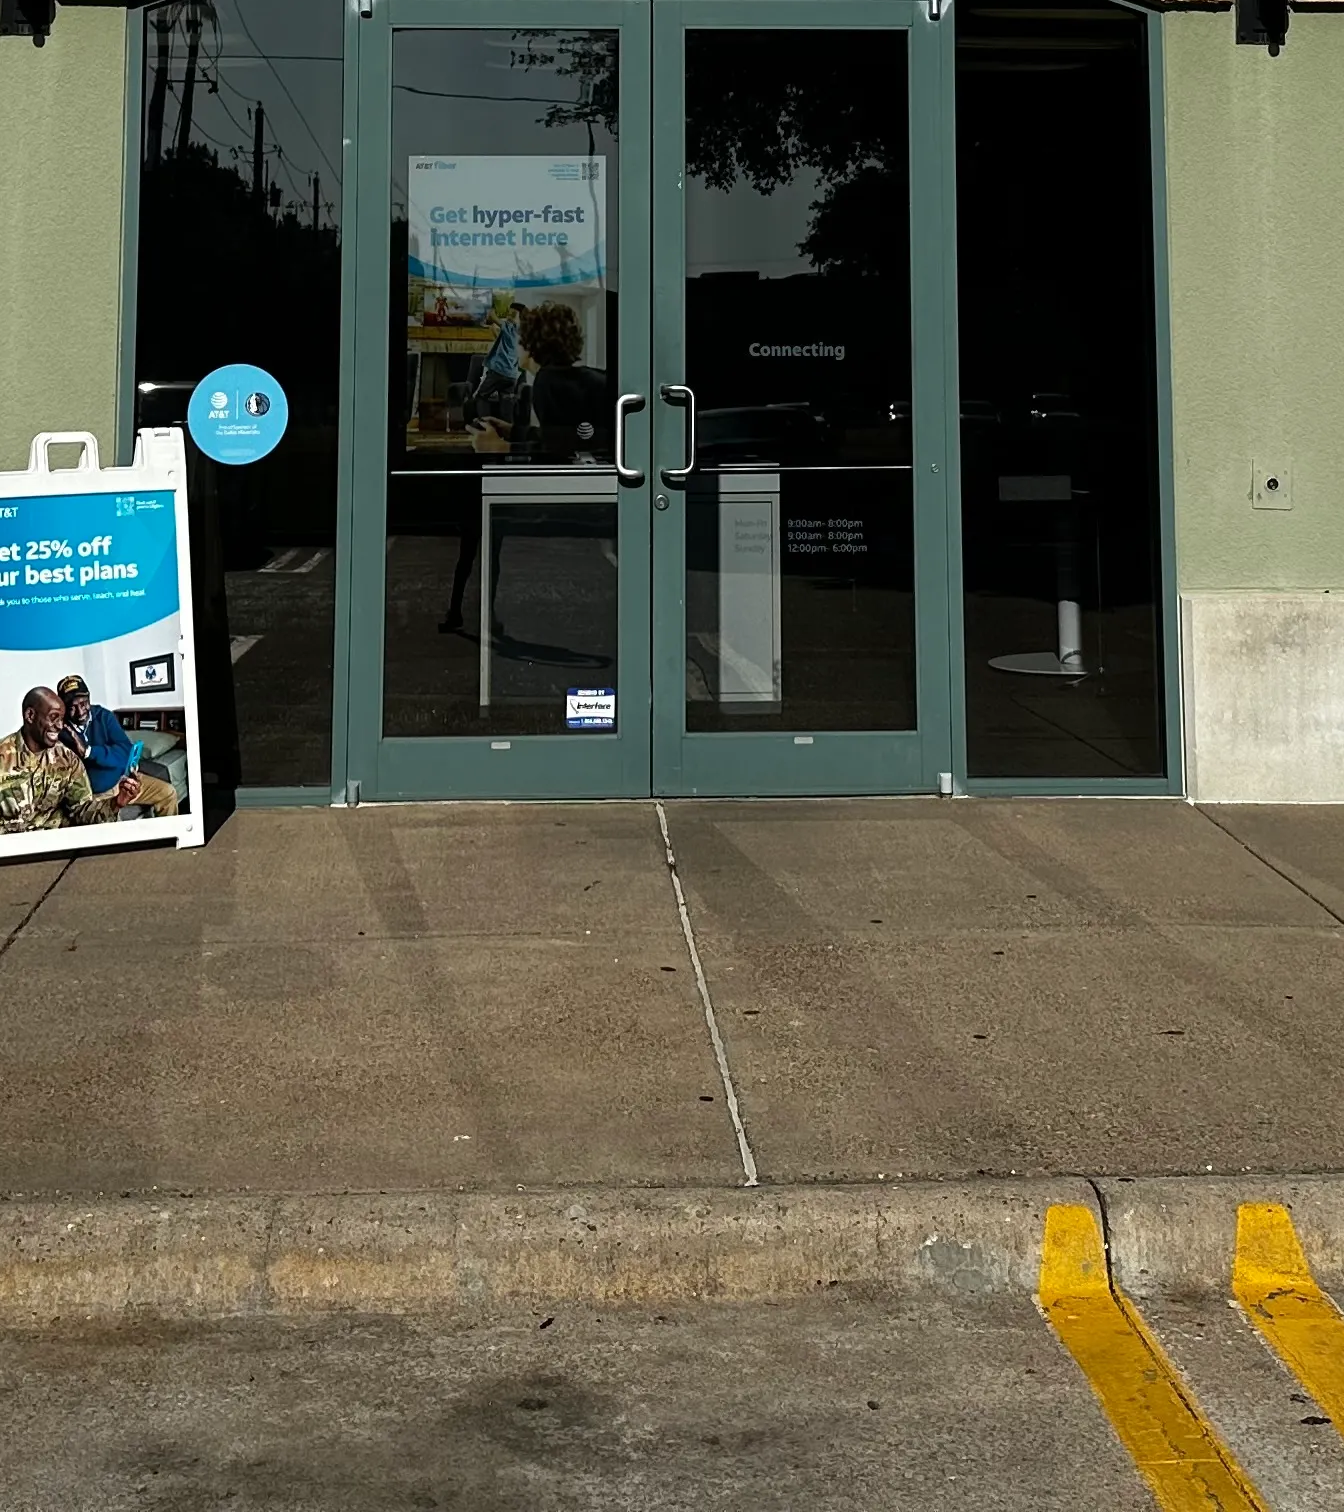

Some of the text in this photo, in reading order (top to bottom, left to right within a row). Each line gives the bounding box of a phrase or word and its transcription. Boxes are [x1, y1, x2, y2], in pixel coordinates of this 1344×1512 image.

[429, 204, 586, 229] Get hyper-fast
[430, 227, 569, 247] internet here
[748, 341, 846, 361] Connecting
[208, 410, 230, 419] AT&T
[827, 519, 863, 529] 8:00pm
[827, 531, 864, 541] 8:00pm
[25, 539, 73, 560] 25%
[77, 536, 113, 557] off
[832, 544, 868, 554] 6:00pm
[25, 564, 74, 585] best
[79, 561, 138, 586] plans
[6, 599, 21, 608] you
[31, 596, 52, 604] those
[115, 589, 129, 598] and
